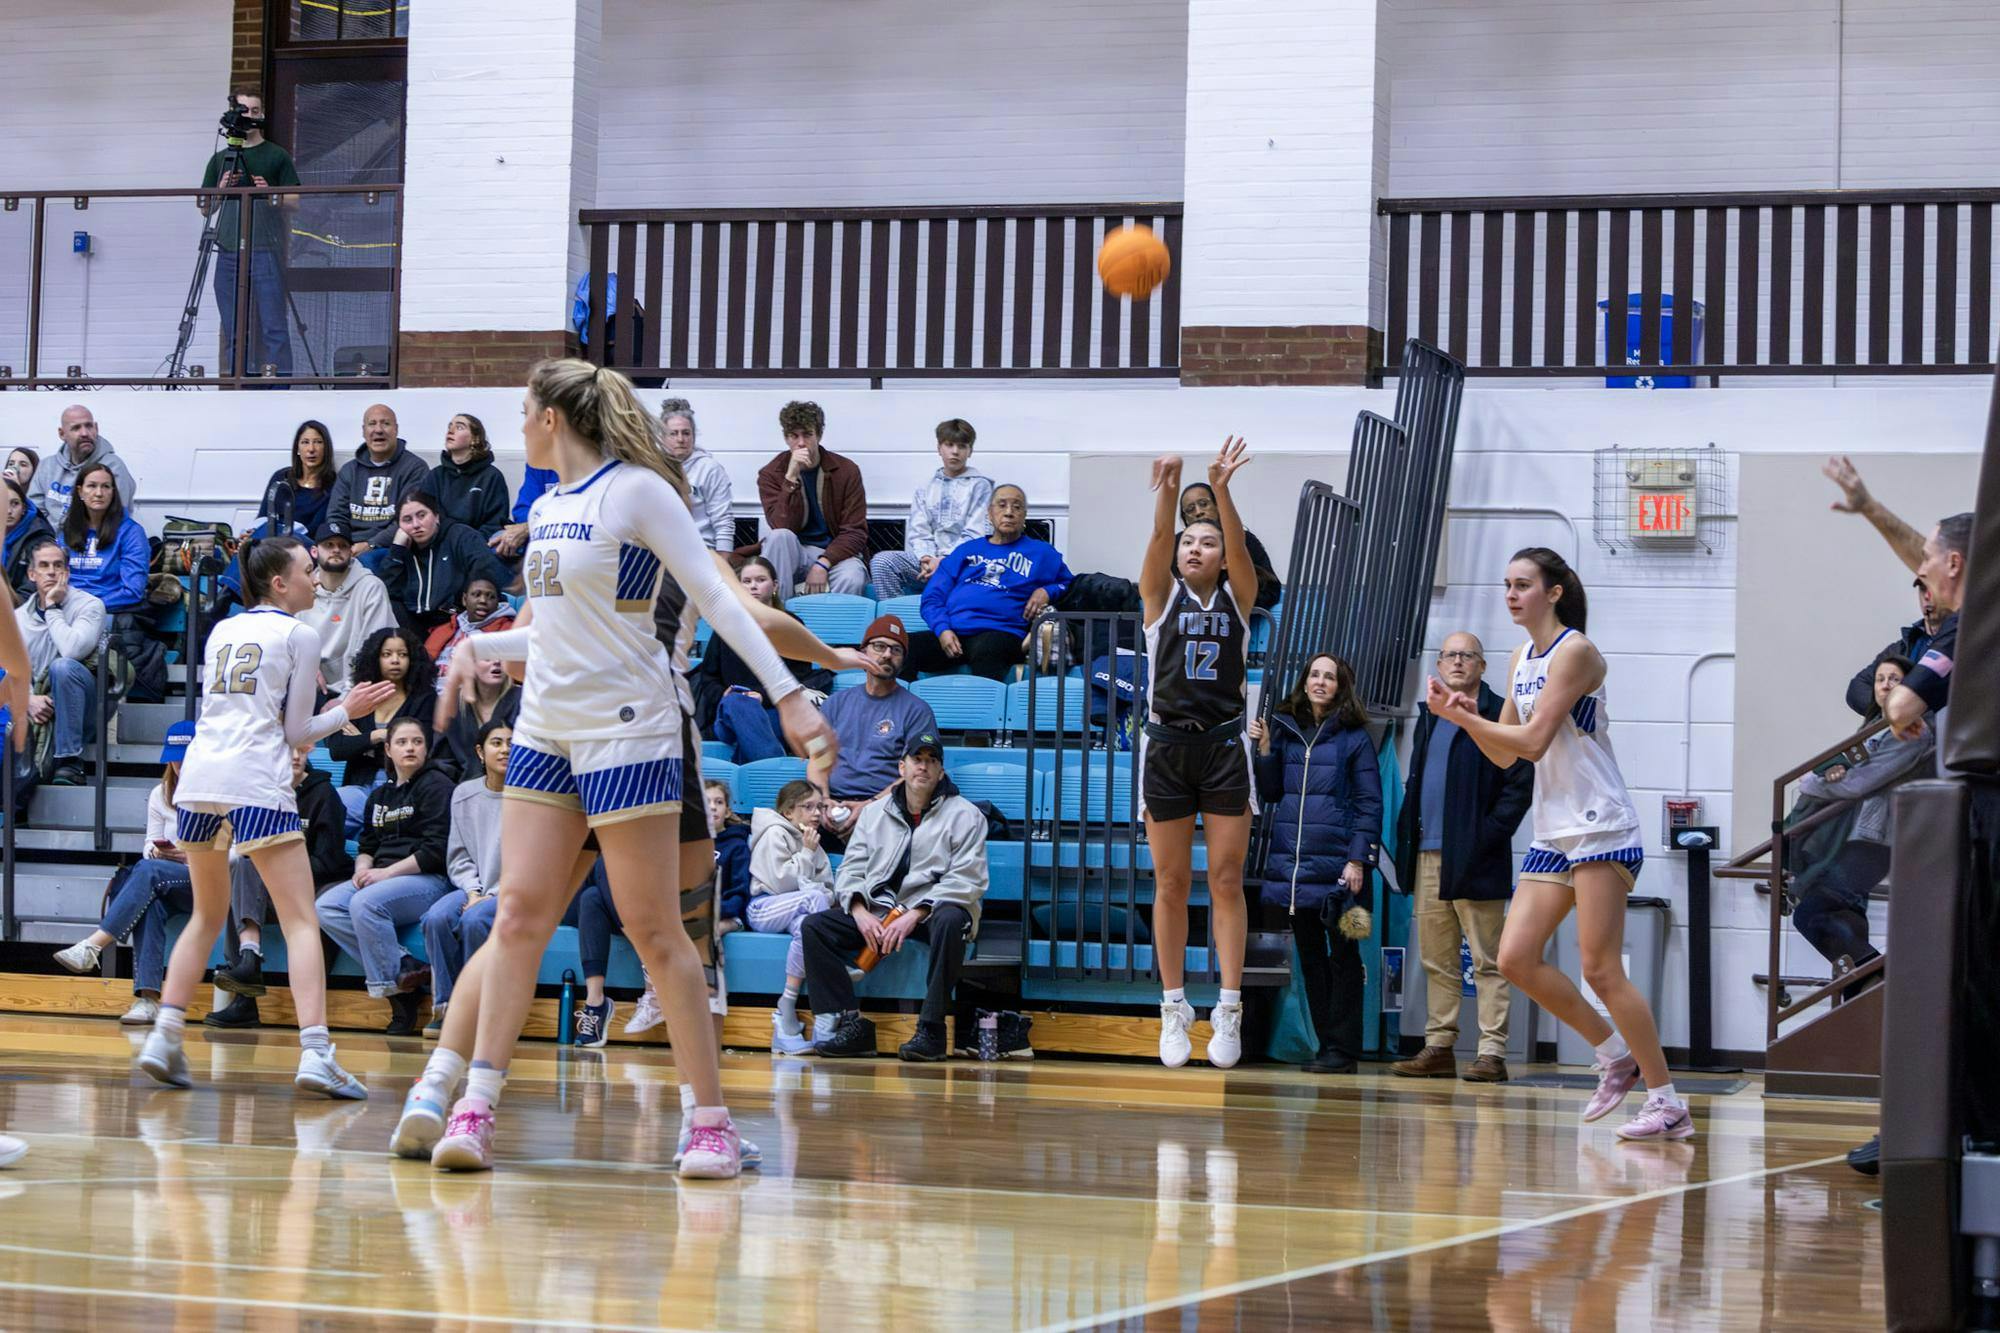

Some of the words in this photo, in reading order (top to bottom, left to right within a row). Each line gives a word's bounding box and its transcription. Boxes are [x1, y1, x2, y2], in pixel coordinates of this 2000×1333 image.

[1639, 495, 1685, 531] EXIT
[528, 549, 563, 598] 22
[1178, 612, 1231, 637] TUFTS
[209, 643, 263, 695] 12
[1185, 640, 1220, 681] 12
